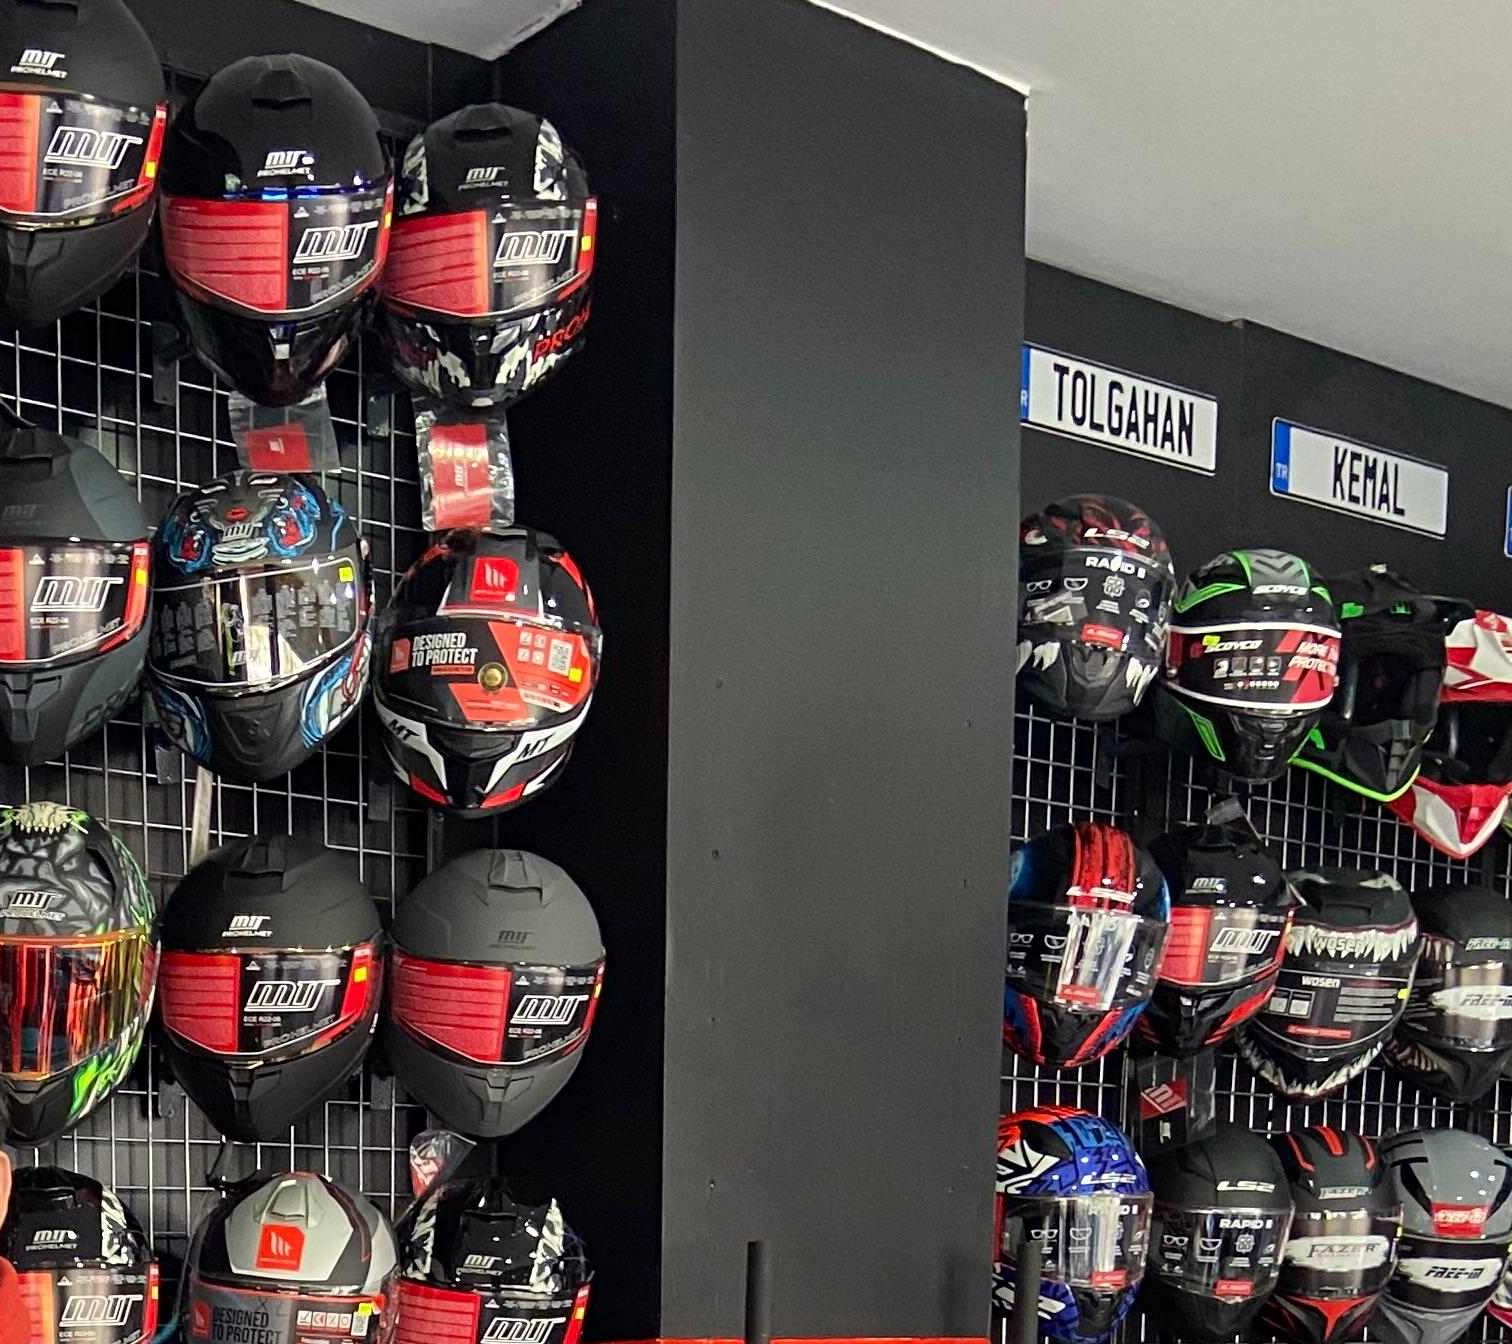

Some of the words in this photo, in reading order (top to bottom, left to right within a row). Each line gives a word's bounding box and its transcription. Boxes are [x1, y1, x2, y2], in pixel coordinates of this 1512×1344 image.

[1053, 363, 1195, 457] TOLGAHAN
[1333, 447, 1406, 517] KEMAL
[1253, 585, 1308, 594] SCOYCO
[413, 632, 466, 650] DESIGNED
[412, 650, 424, 666] TO
[425, 648, 478, 665] PROTECT
[517, 732, 556, 760] MT
[1081, 1173, 1136, 1185] LS2
[1217, 1181, 1275, 1193] LS2
[1219, 1219, 1263, 1229] RAPID
[212, 1307, 268, 1328] DESIGNED
[212, 1323, 224, 1340] TO
